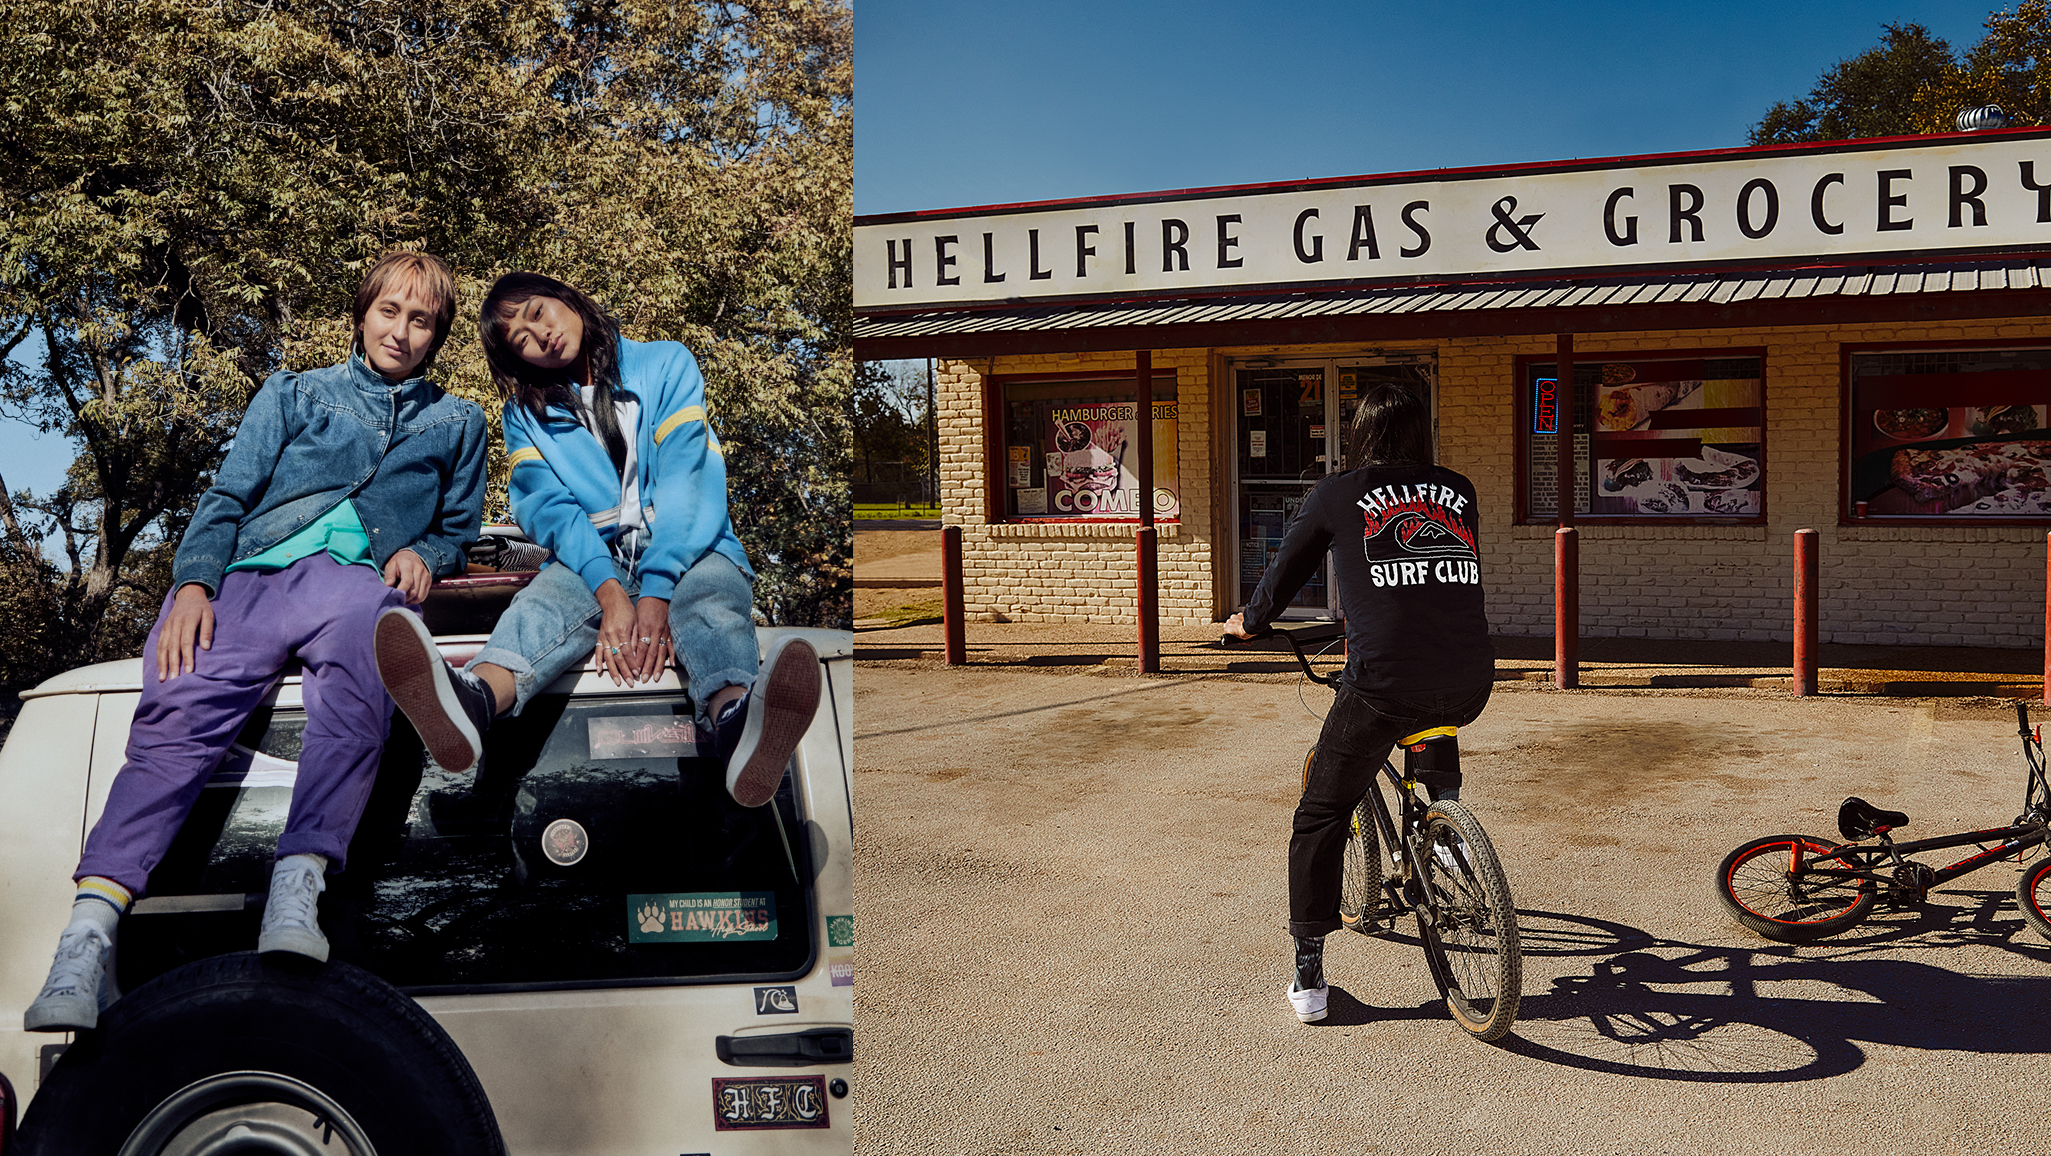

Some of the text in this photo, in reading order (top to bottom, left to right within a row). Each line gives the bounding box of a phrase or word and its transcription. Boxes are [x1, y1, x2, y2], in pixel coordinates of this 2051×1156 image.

[886, 160, 2051, 290] HELLFIRE GAS & GROCERY
[1300, 380, 1321, 401] 21
[1052, 407, 1133, 422] HAMBURGER
[1151, 405, 1178, 419] RIES
[1538, 380, 1556, 431] OPEN
[1370, 560, 1479, 588] SURF CLUB
[669, 897, 766, 908] MY CHILD IS AN HONOR STUDENT AT
[670, 909, 769, 931] HAWKINS
[710, 920, 769, 938] High School
